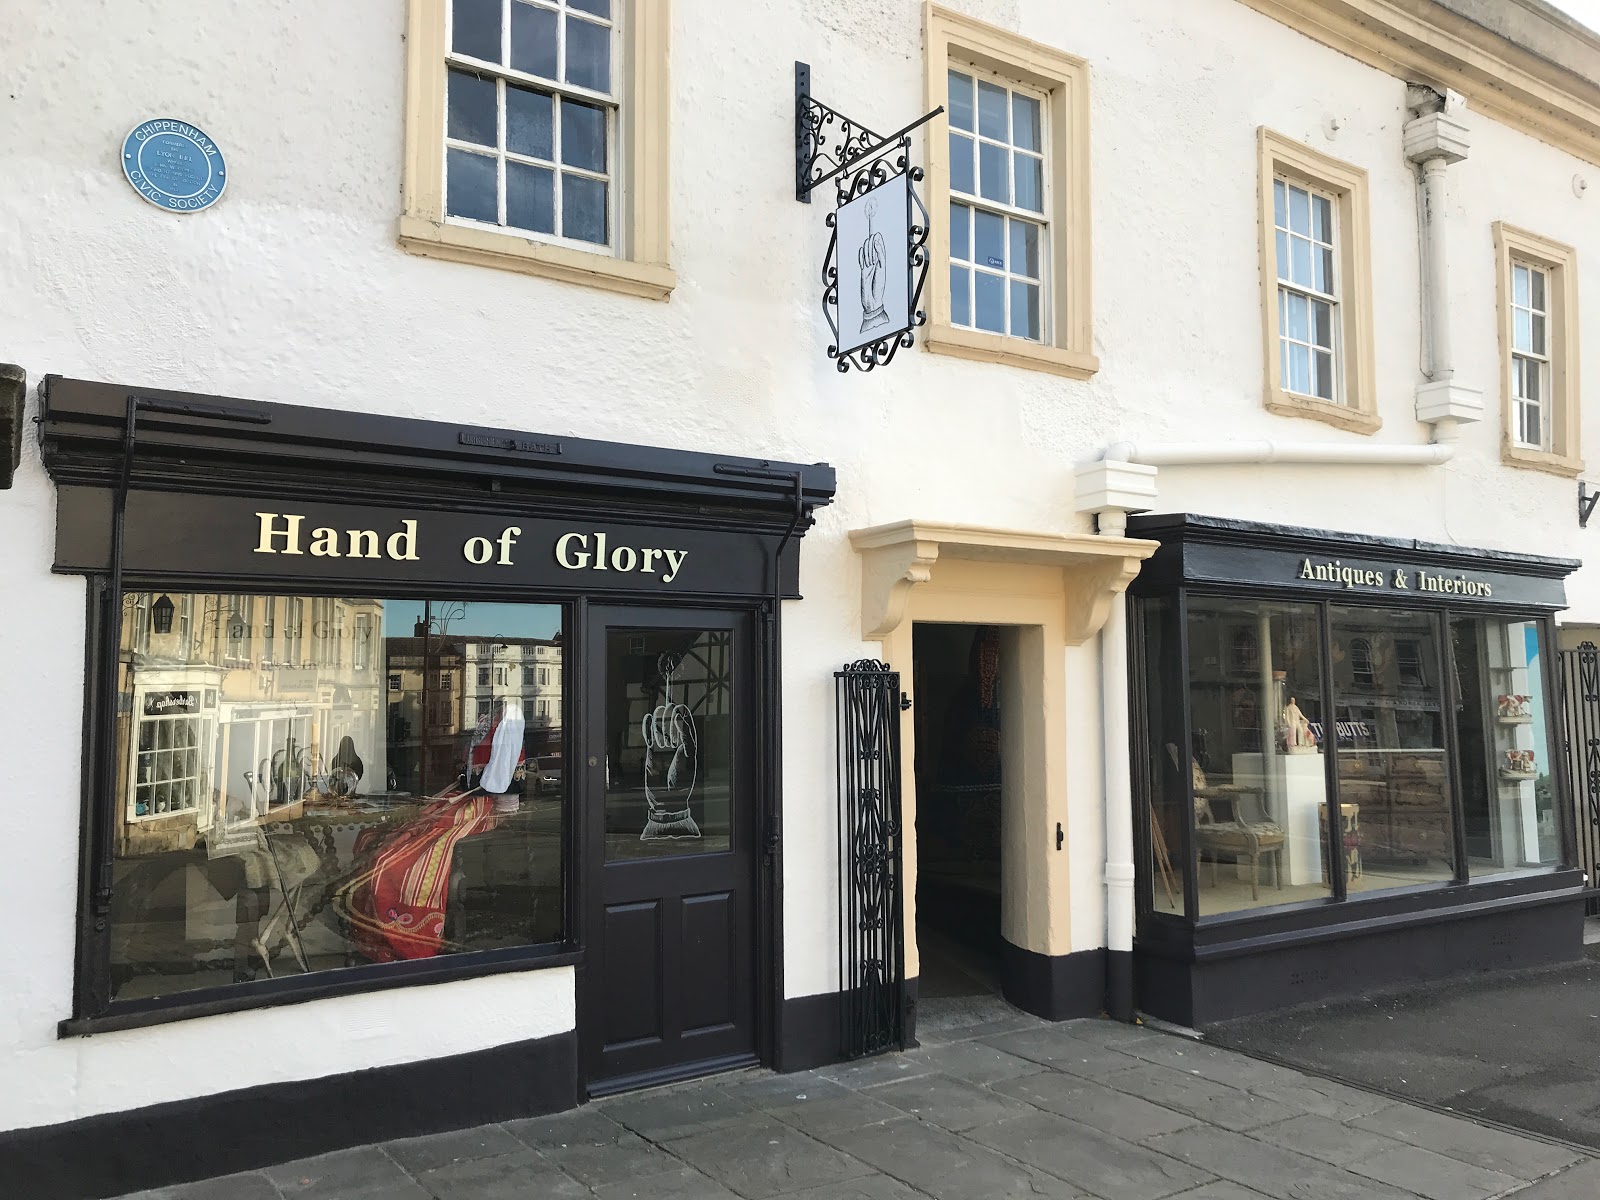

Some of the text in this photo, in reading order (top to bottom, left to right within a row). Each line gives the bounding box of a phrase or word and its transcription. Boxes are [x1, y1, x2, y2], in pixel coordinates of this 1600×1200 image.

[135, 121, 217, 156] CHIPPENHAM
[130, 170, 162, 201] CIVIC
[168, 184, 219, 209] SOCIETY
[253, 511, 689, 583] Hand of Glory
[1300, 557, 1493, 597] Antiques & Interiors
[1336, 721, 1370, 738] BUTTS
